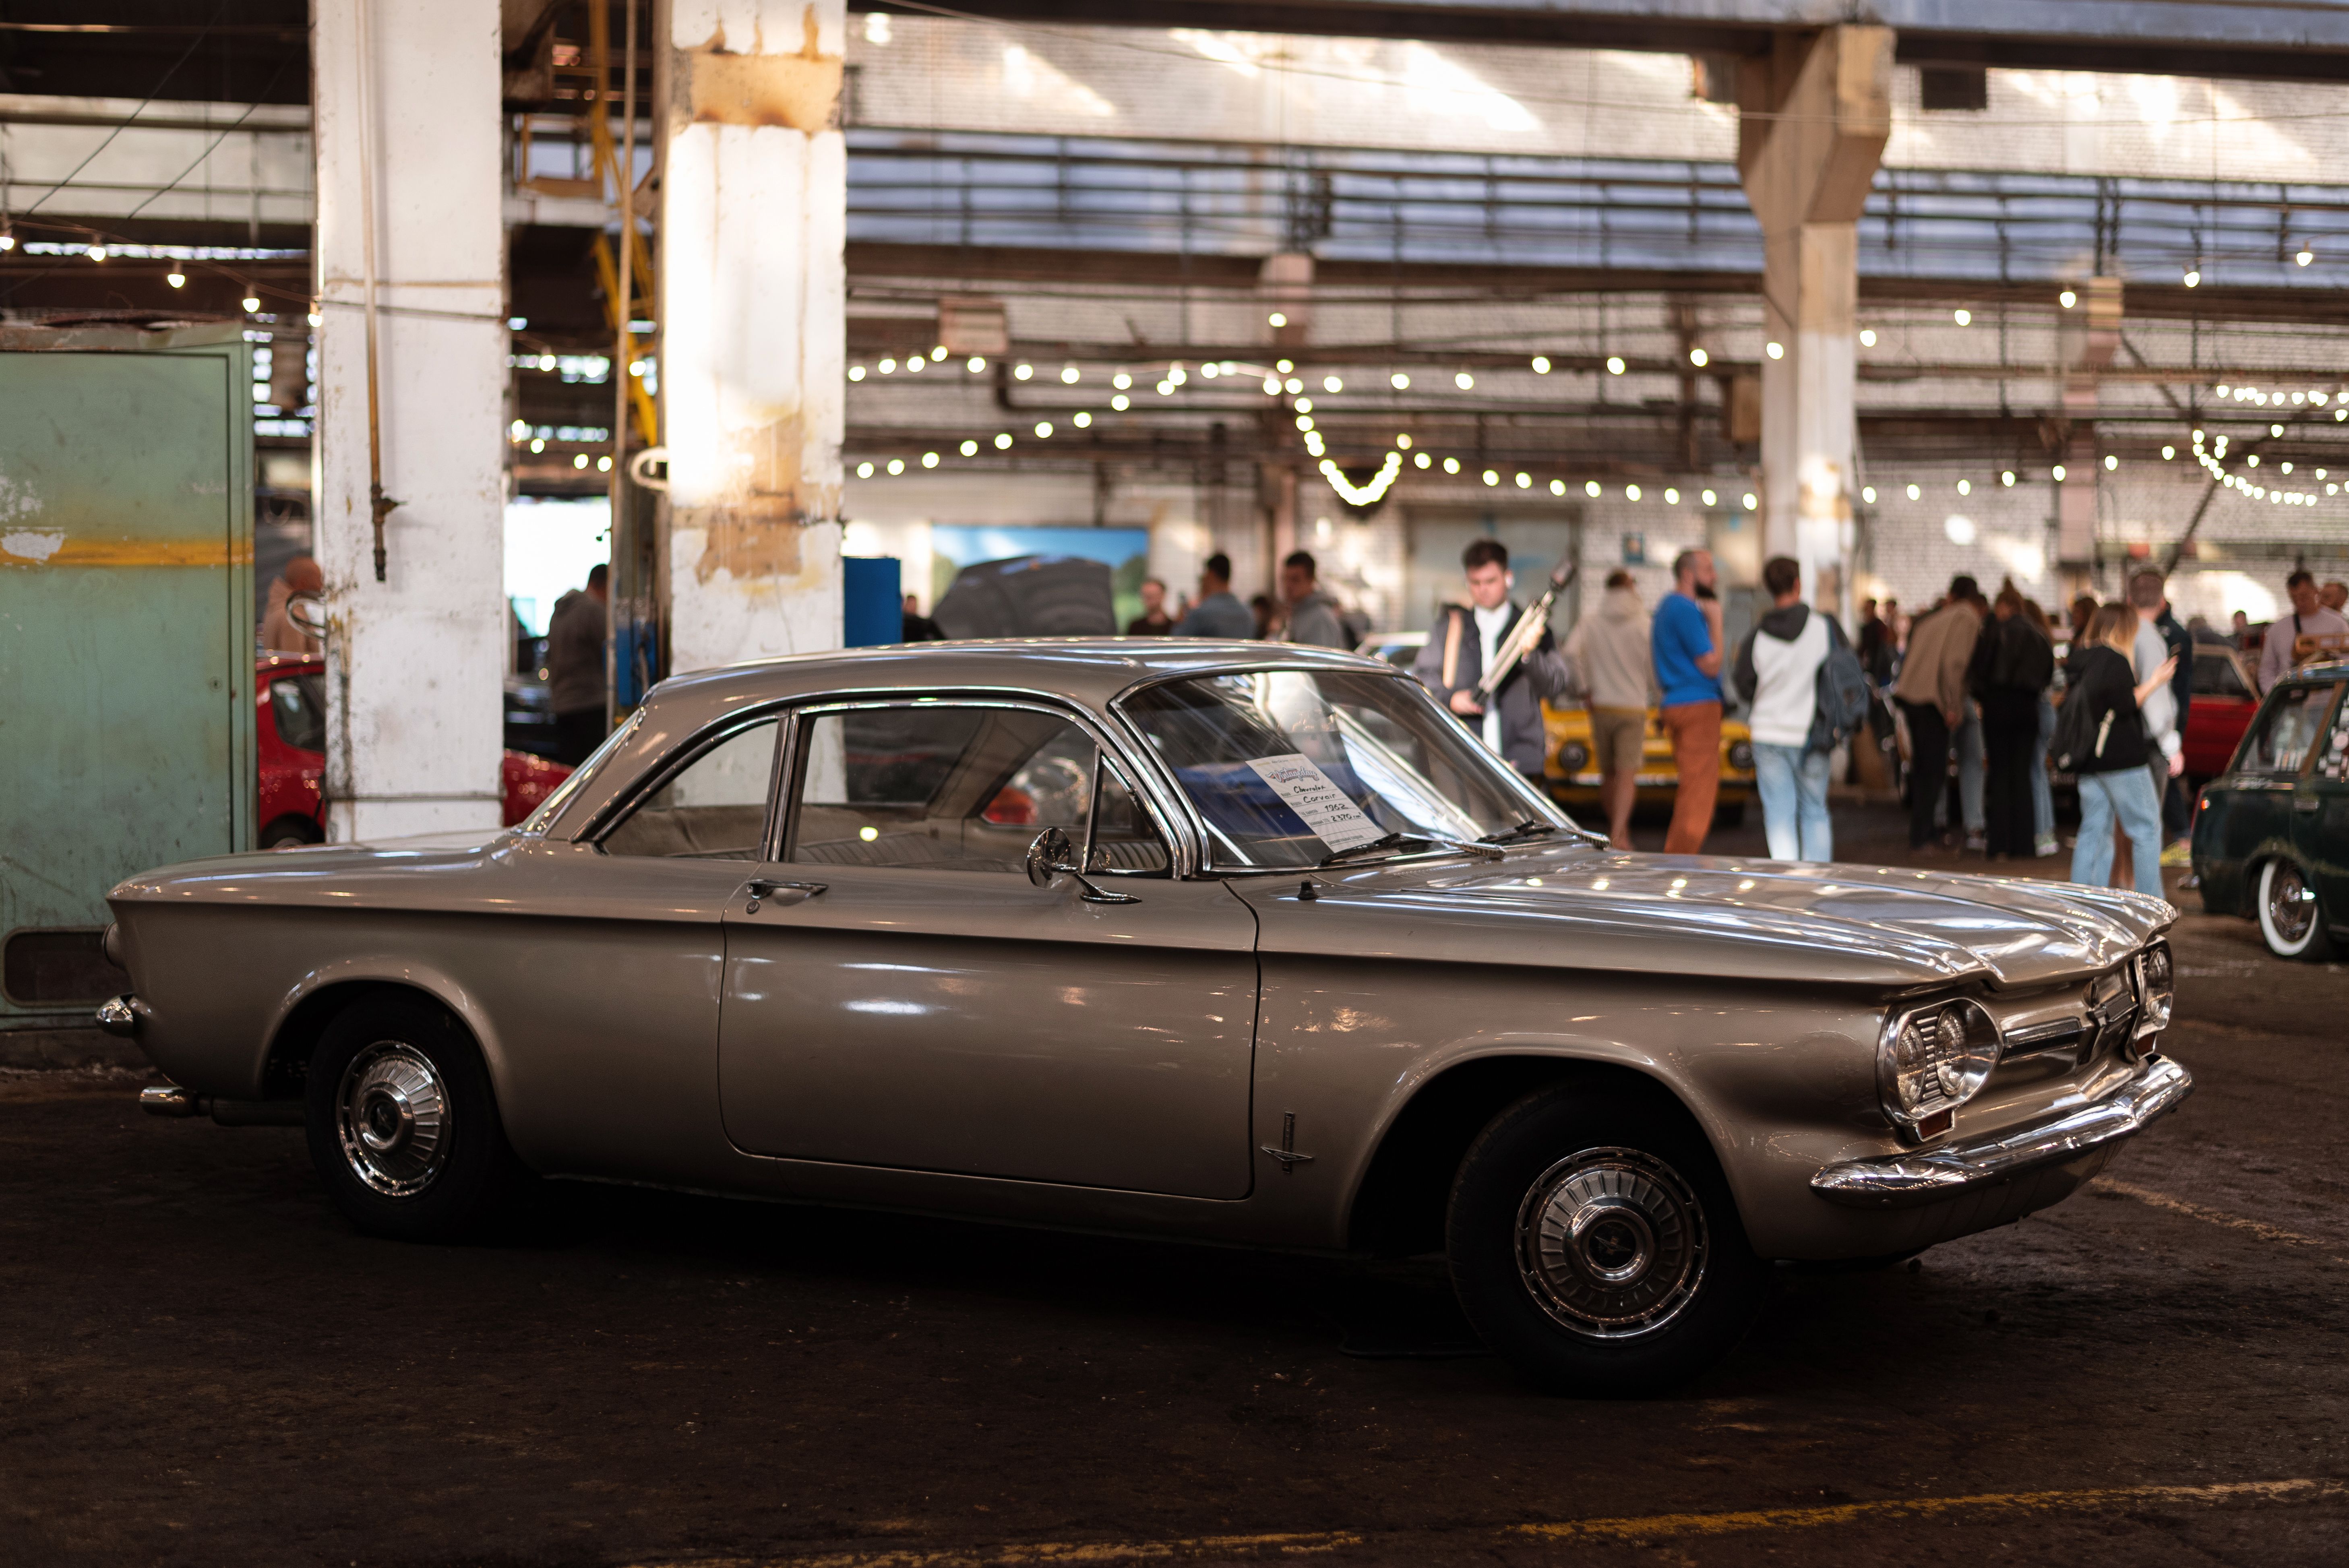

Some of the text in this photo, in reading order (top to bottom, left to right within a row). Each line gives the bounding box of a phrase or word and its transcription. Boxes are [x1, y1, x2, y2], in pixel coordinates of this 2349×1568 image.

[1265, 766, 1320, 783] Vintageday
[1294, 785, 1326, 793] Chevrolet
[1303, 793, 1336, 803] Corvair
[1325, 804, 1348, 812] 1962
[1331, 814, 1352, 822] 2370
